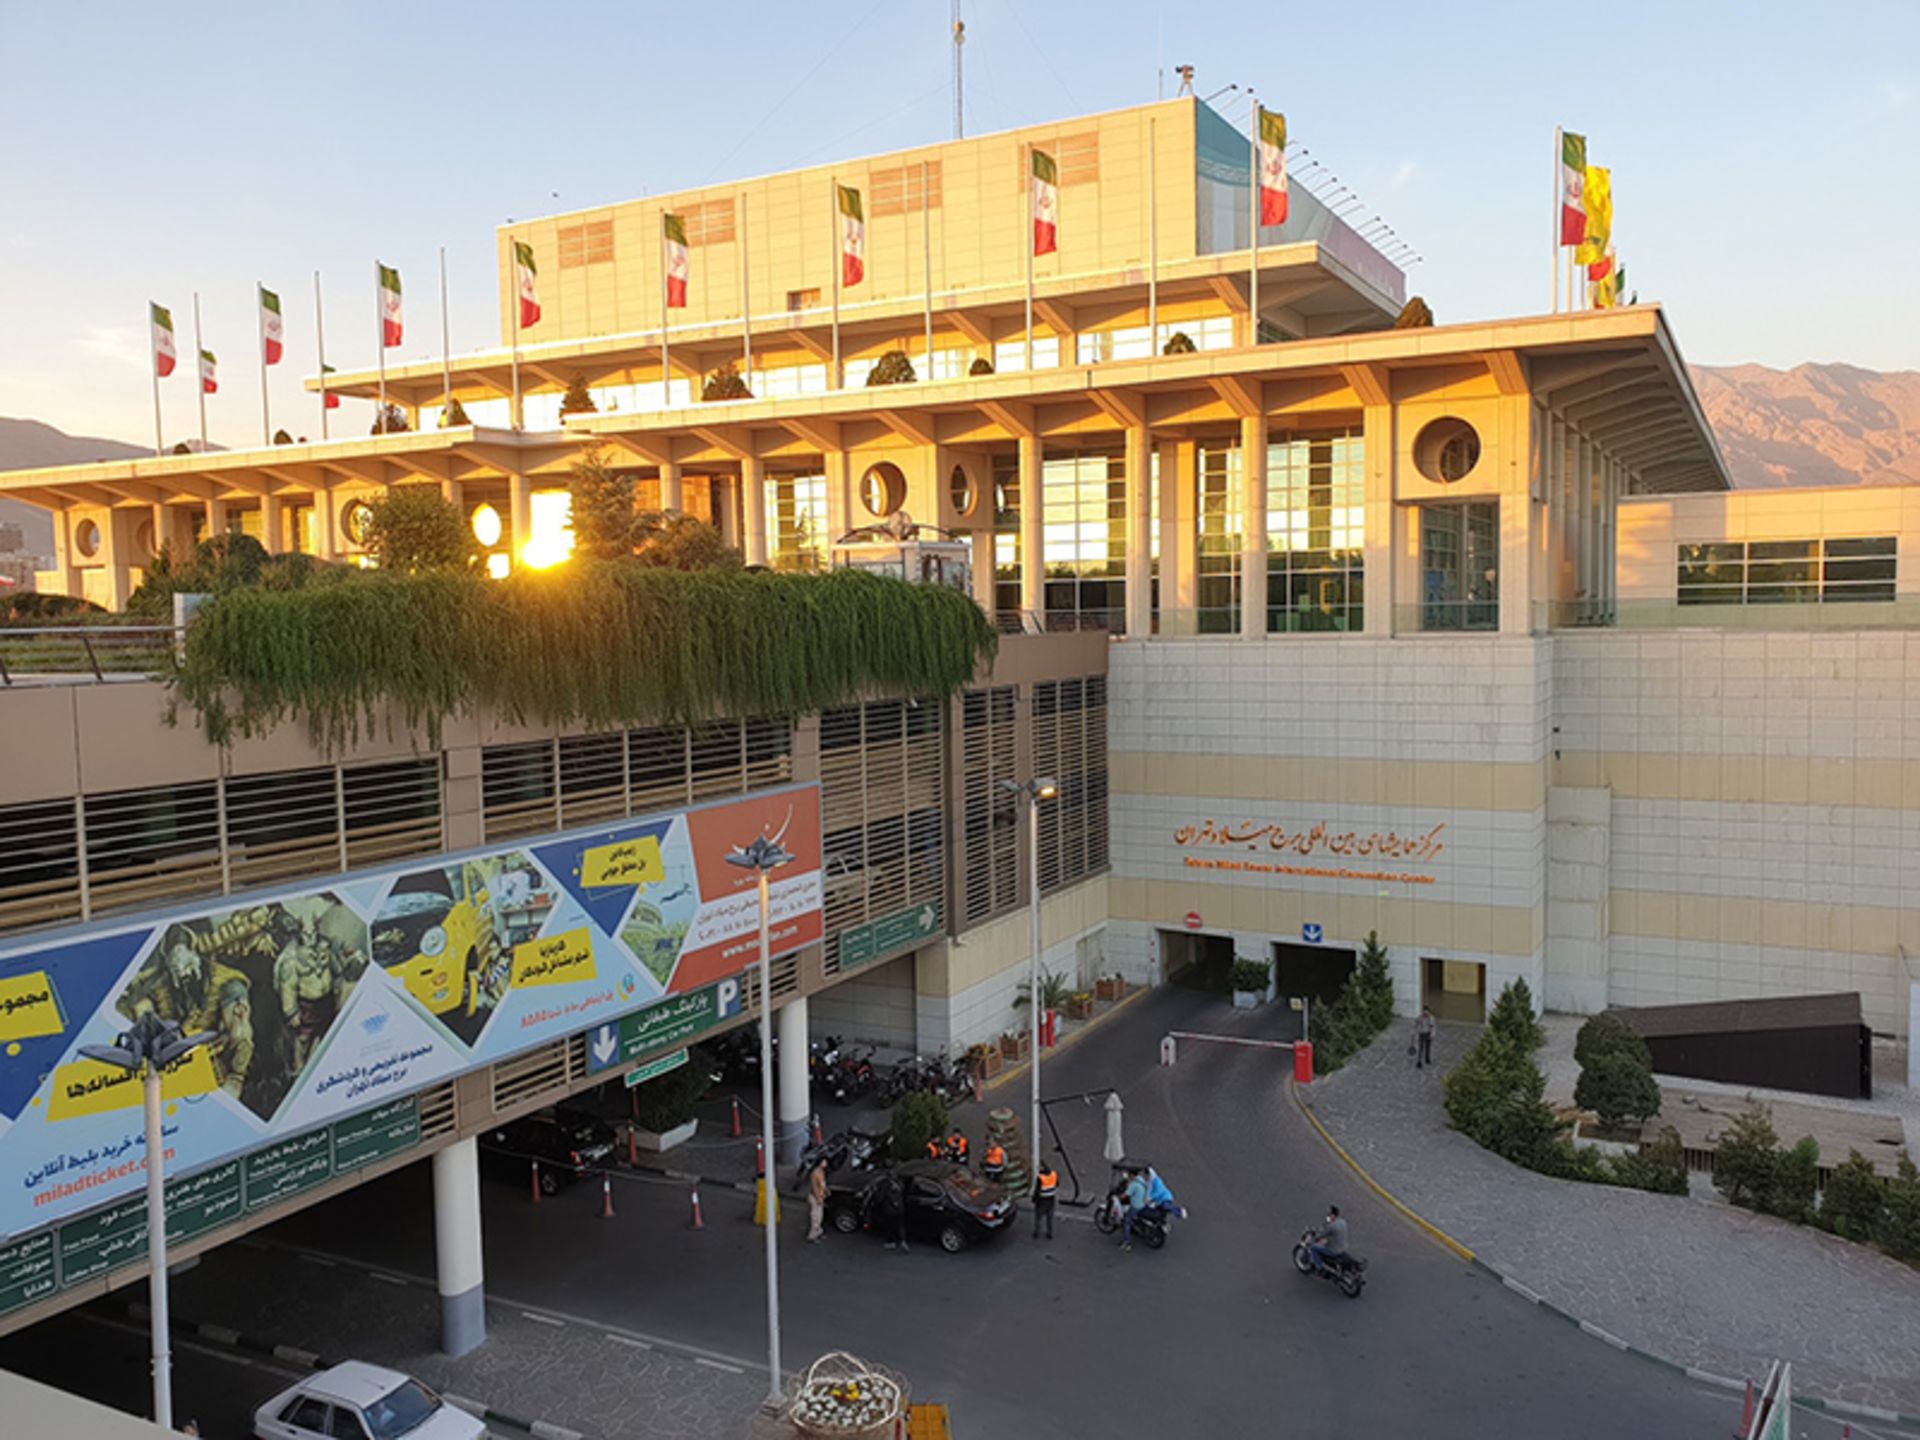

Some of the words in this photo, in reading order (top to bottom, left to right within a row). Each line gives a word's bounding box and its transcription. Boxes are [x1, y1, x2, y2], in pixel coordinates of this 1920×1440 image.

[1174, 819, 1213, 845] تهران
[1416, 822, 1445, 861] مرکز
[673, 993, 710, 1016] پارکینگ
[717, 977, 739, 1019] P
[637, 1005, 671, 1032] طبقاتی
[67, 1149, 99, 1170] بلیط
[101, 1135, 132, 1159] خرید
[24, 1154, 65, 1188] آنلاین
[33, 1147, 176, 1207] miladticket.cm
